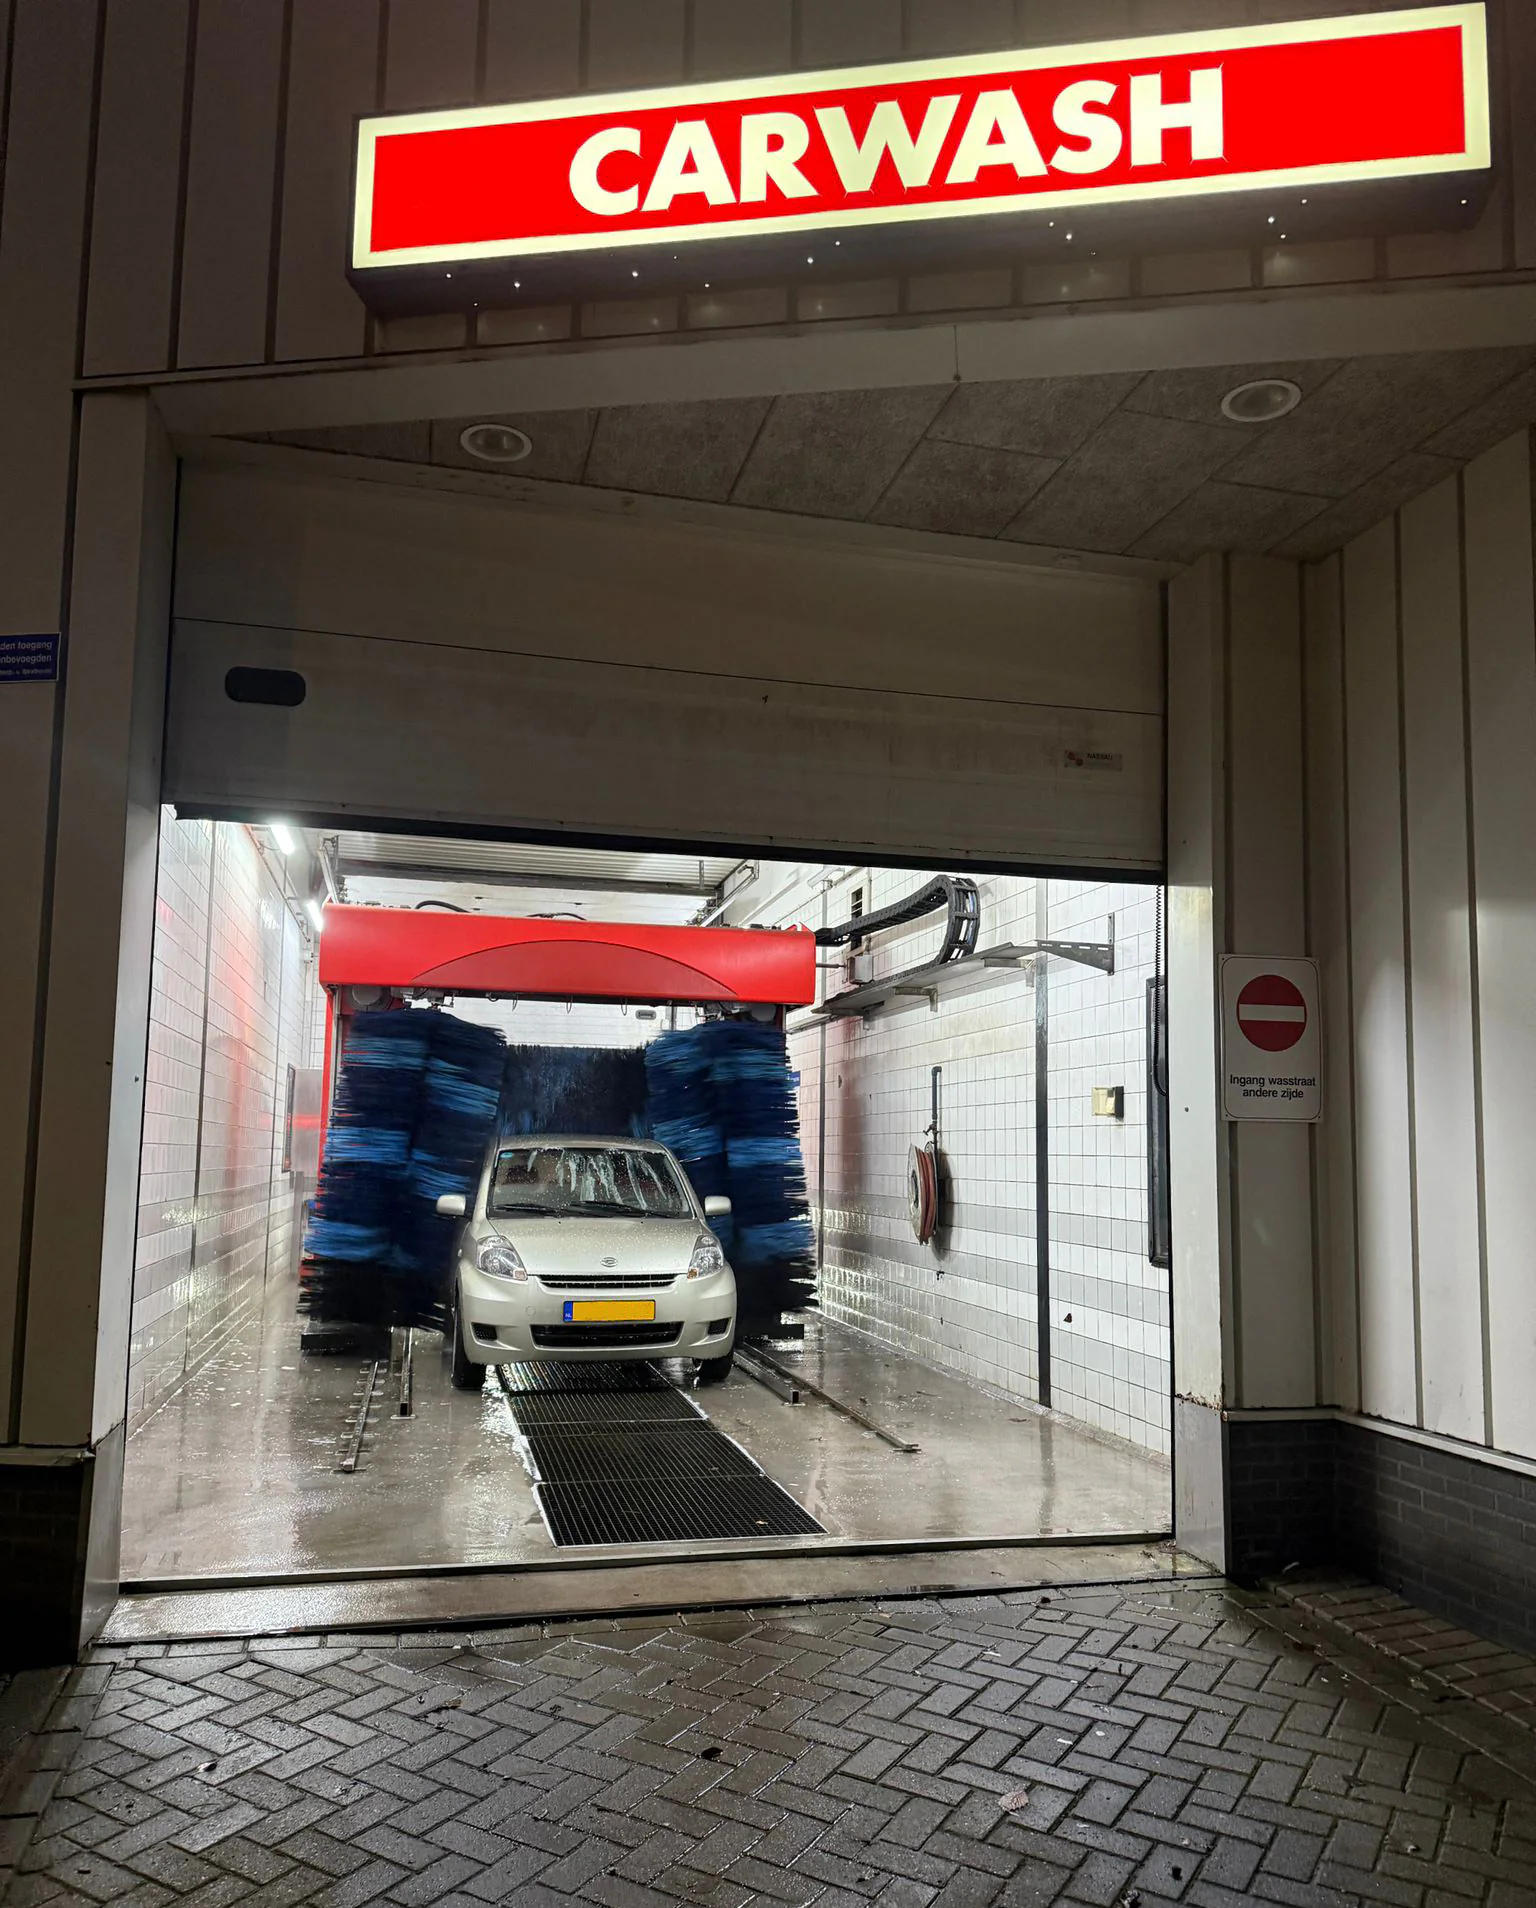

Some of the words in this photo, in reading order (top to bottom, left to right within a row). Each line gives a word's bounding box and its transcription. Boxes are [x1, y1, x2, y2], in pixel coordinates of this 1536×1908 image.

[568, 66, 1226, 216] CARWASH
[18, 641, 53, 652] toegang
[1230, 1074, 1265, 1087] Ingang
[1268, 1077, 1316, 1087] wasstraat
[1243, 1088, 1278, 1098] andere
[1281, 1088, 1304, 1100] zijde
